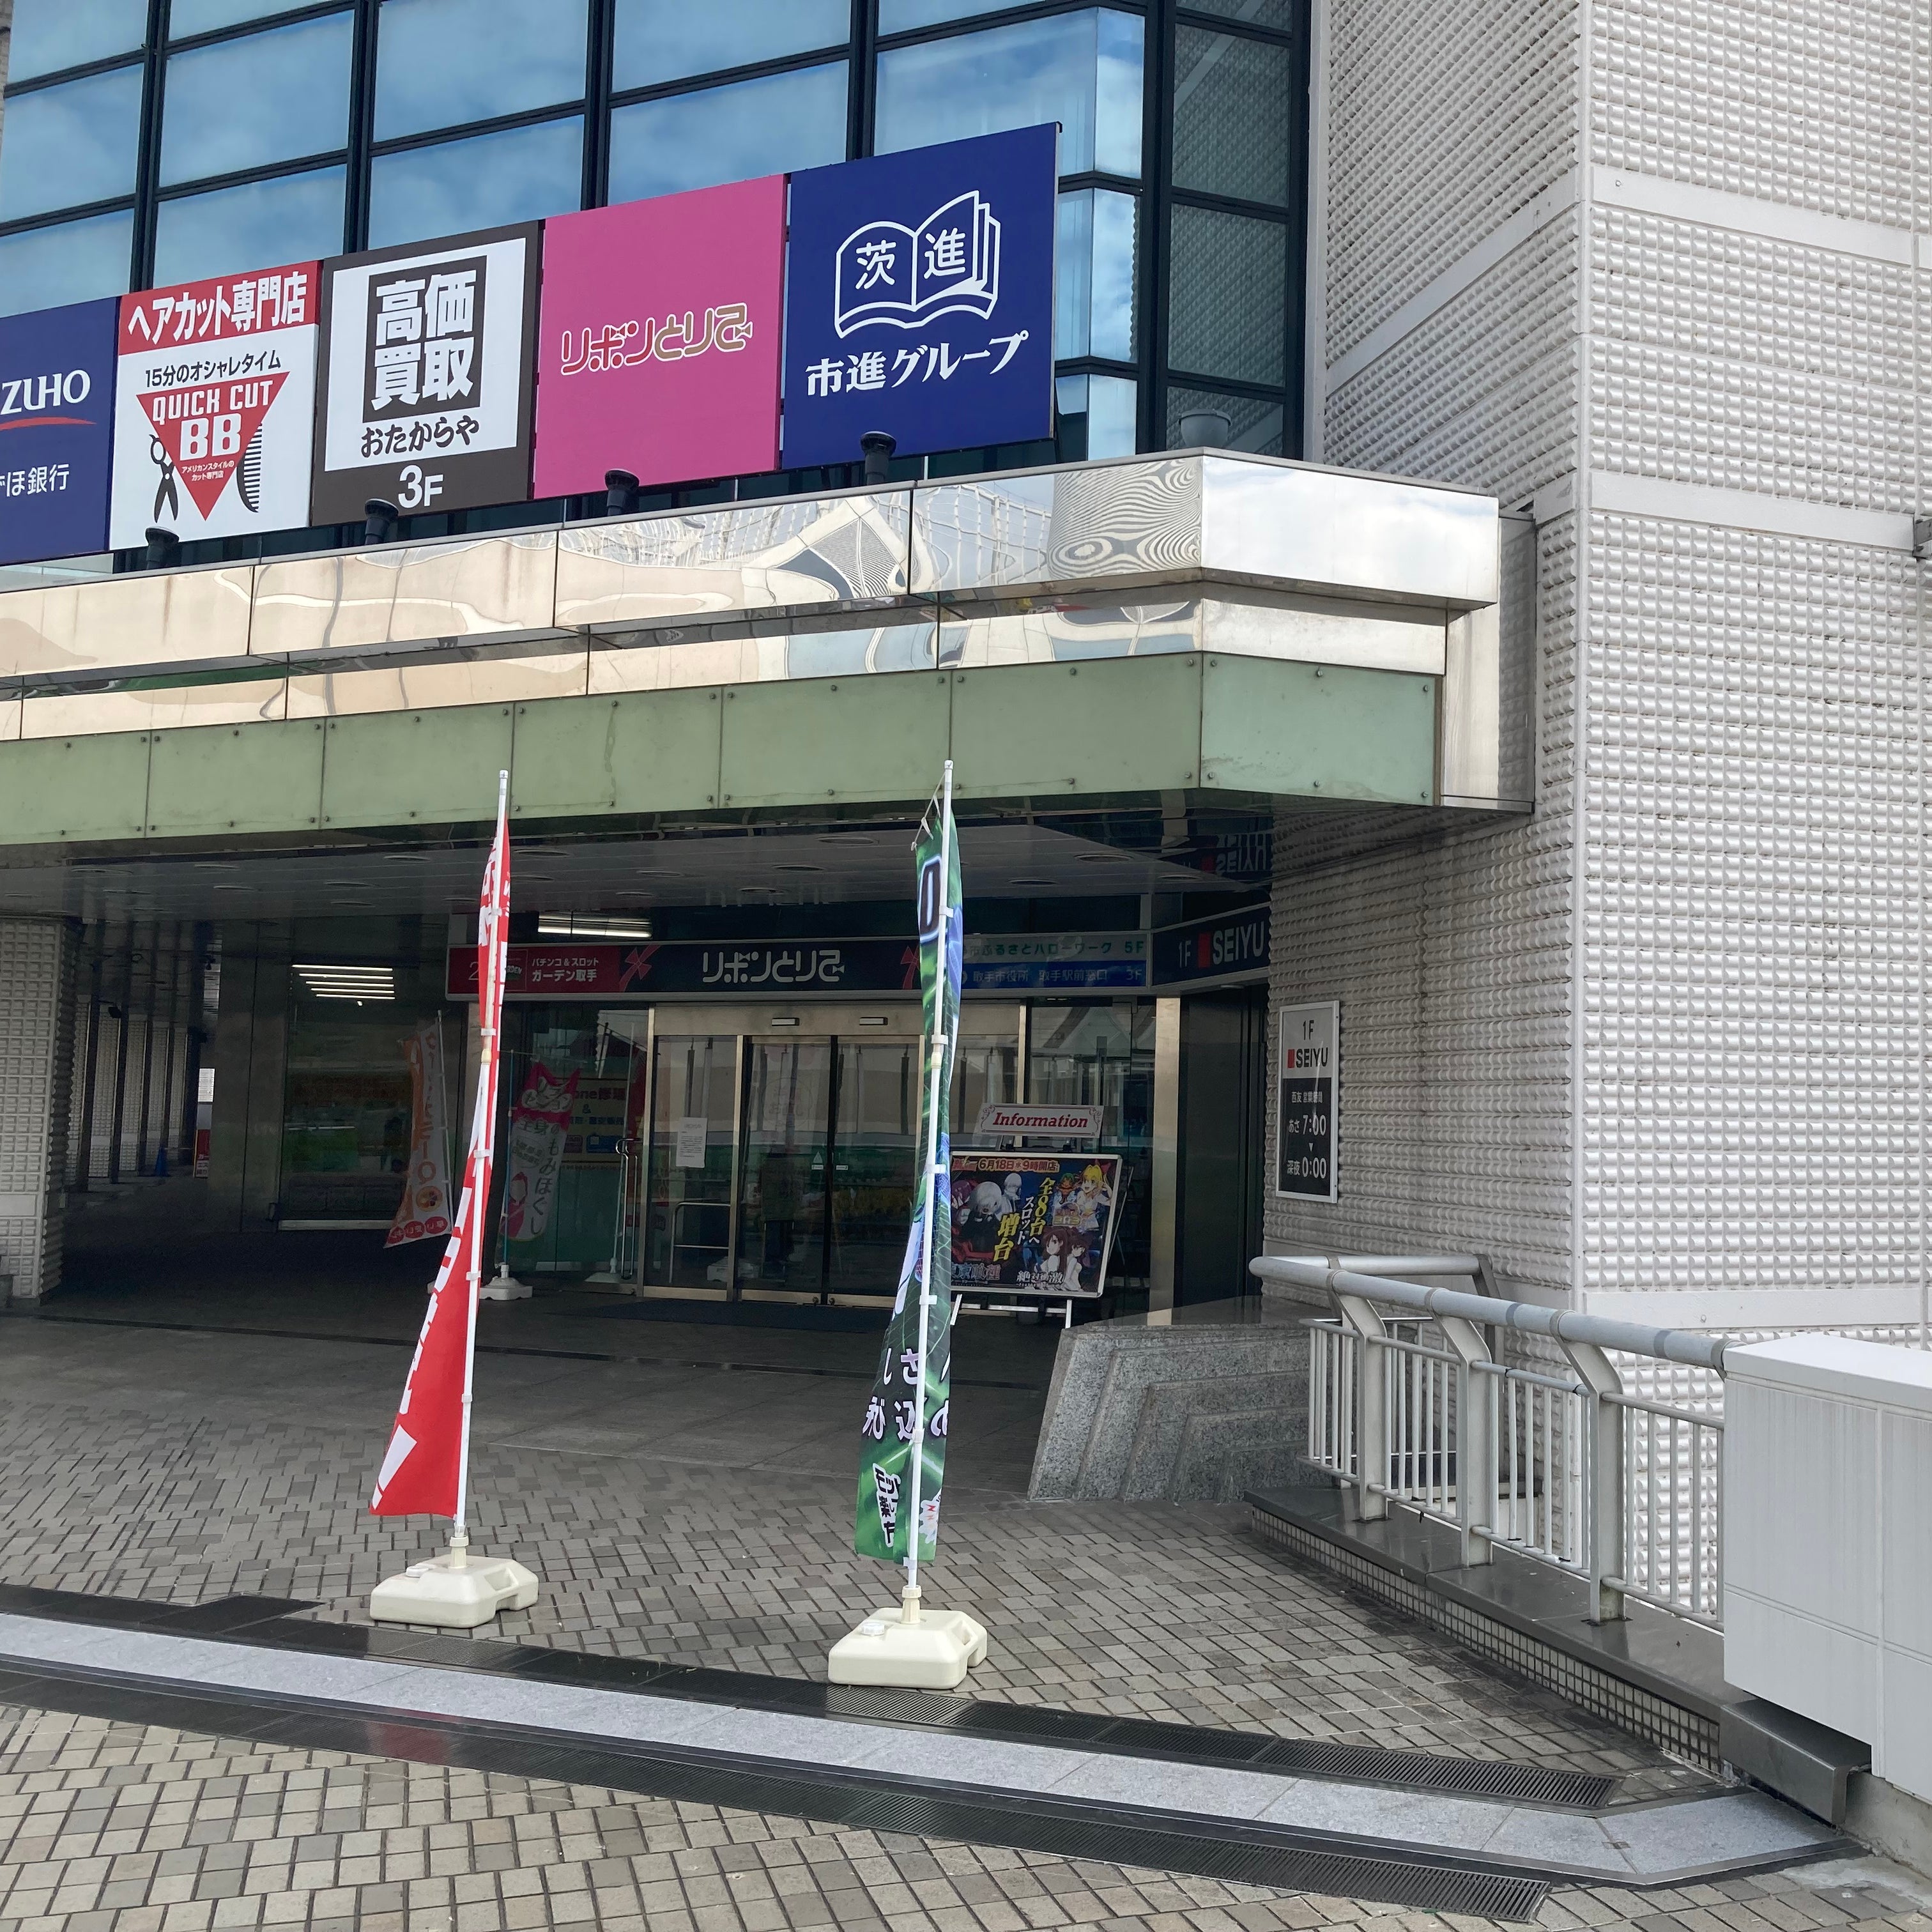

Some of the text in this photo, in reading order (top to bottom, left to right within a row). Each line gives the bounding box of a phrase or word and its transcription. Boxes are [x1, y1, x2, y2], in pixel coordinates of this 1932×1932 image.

[128, 271, 308, 344] ヘアカット専門店
[376, 270, 477, 346] 高価
[561, 302, 753, 376] リボンとりで
[146, 349, 281, 388] 15分のオシャレタイム
[371, 337, 475, 411] 買取
[804, 330, 1029, 399] 市進グループ
[152, 379, 273, 425] QUICK CUT
[180, 413, 242, 461] BB
[360, 415, 479, 458] おたからや
[181, 460, 234, 474] アメリカンスタイルの
[192, 470, 224, 481] カット専門店
[398, 465, 443, 507] 3F
[1124, 940, 1145, 954] 5F
[1178, 921, 1264, 969] 1F SEIYU
[532, 969, 597, 982] ガーデン取手
[702, 949, 845, 983] リボンとりで
[972, 968, 1144, 983] 取手市役所 取手駅前窓口 3F
[1303, 1020, 1314, 1041] 1F
[1296, 1046, 1328, 1068] SEIYU
[1303, 1090, 1323, 1103] 営業時間
[992, 1112, 1089, 1128] Information
[1289, 1114, 1326, 1136] あさ 7:00
[1287, 1156, 1326, 1179] 深夜 0:00
[993, 1213, 1020, 1262] 増台
[1016, 1196, 1035, 1246] スロット
